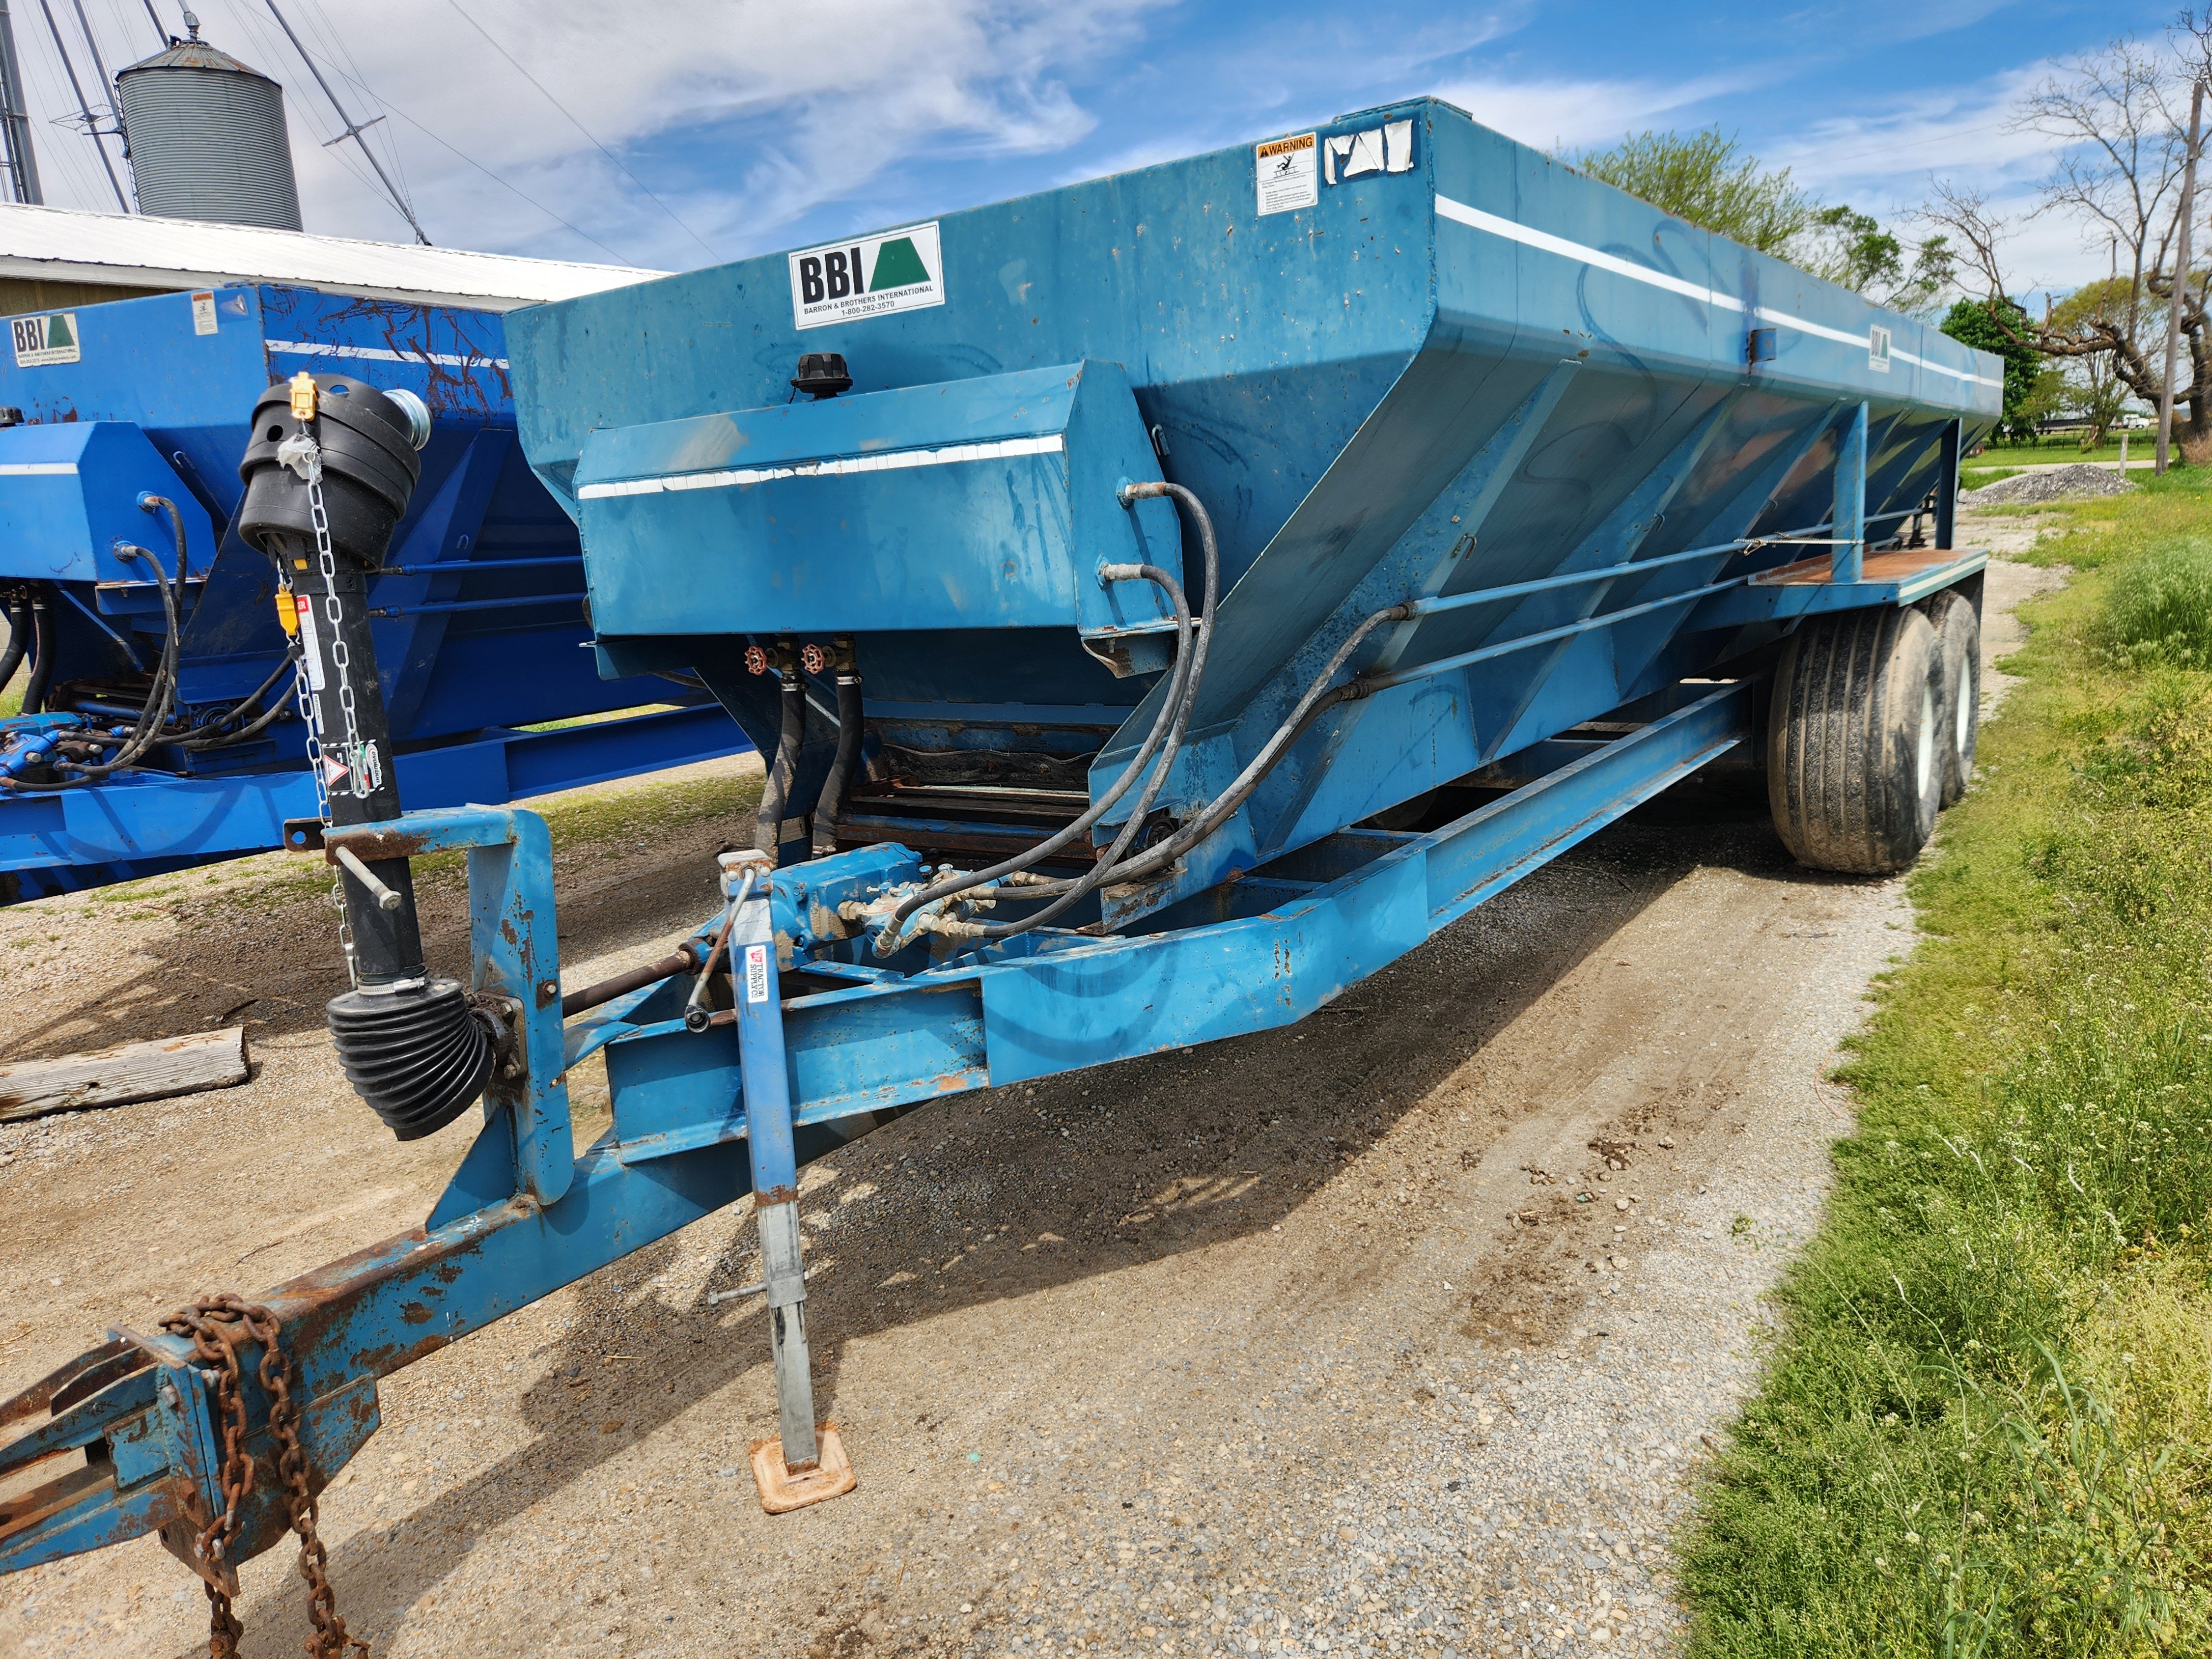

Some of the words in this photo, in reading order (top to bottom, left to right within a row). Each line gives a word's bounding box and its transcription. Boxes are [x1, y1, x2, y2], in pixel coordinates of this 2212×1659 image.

[1269, 137, 1312, 155] WARNING
[799, 247, 864, 305] BBI
[804, 304, 832, 315] BARRON
[841, 296, 876, 308] BROTHERS
[878, 285, 933, 301] INTERNATIONAL
[841, 301, 895, 316] 1-800-282-3570
[13, 319, 45, 352] BBI
[372, 752, 380, 784] evolution
